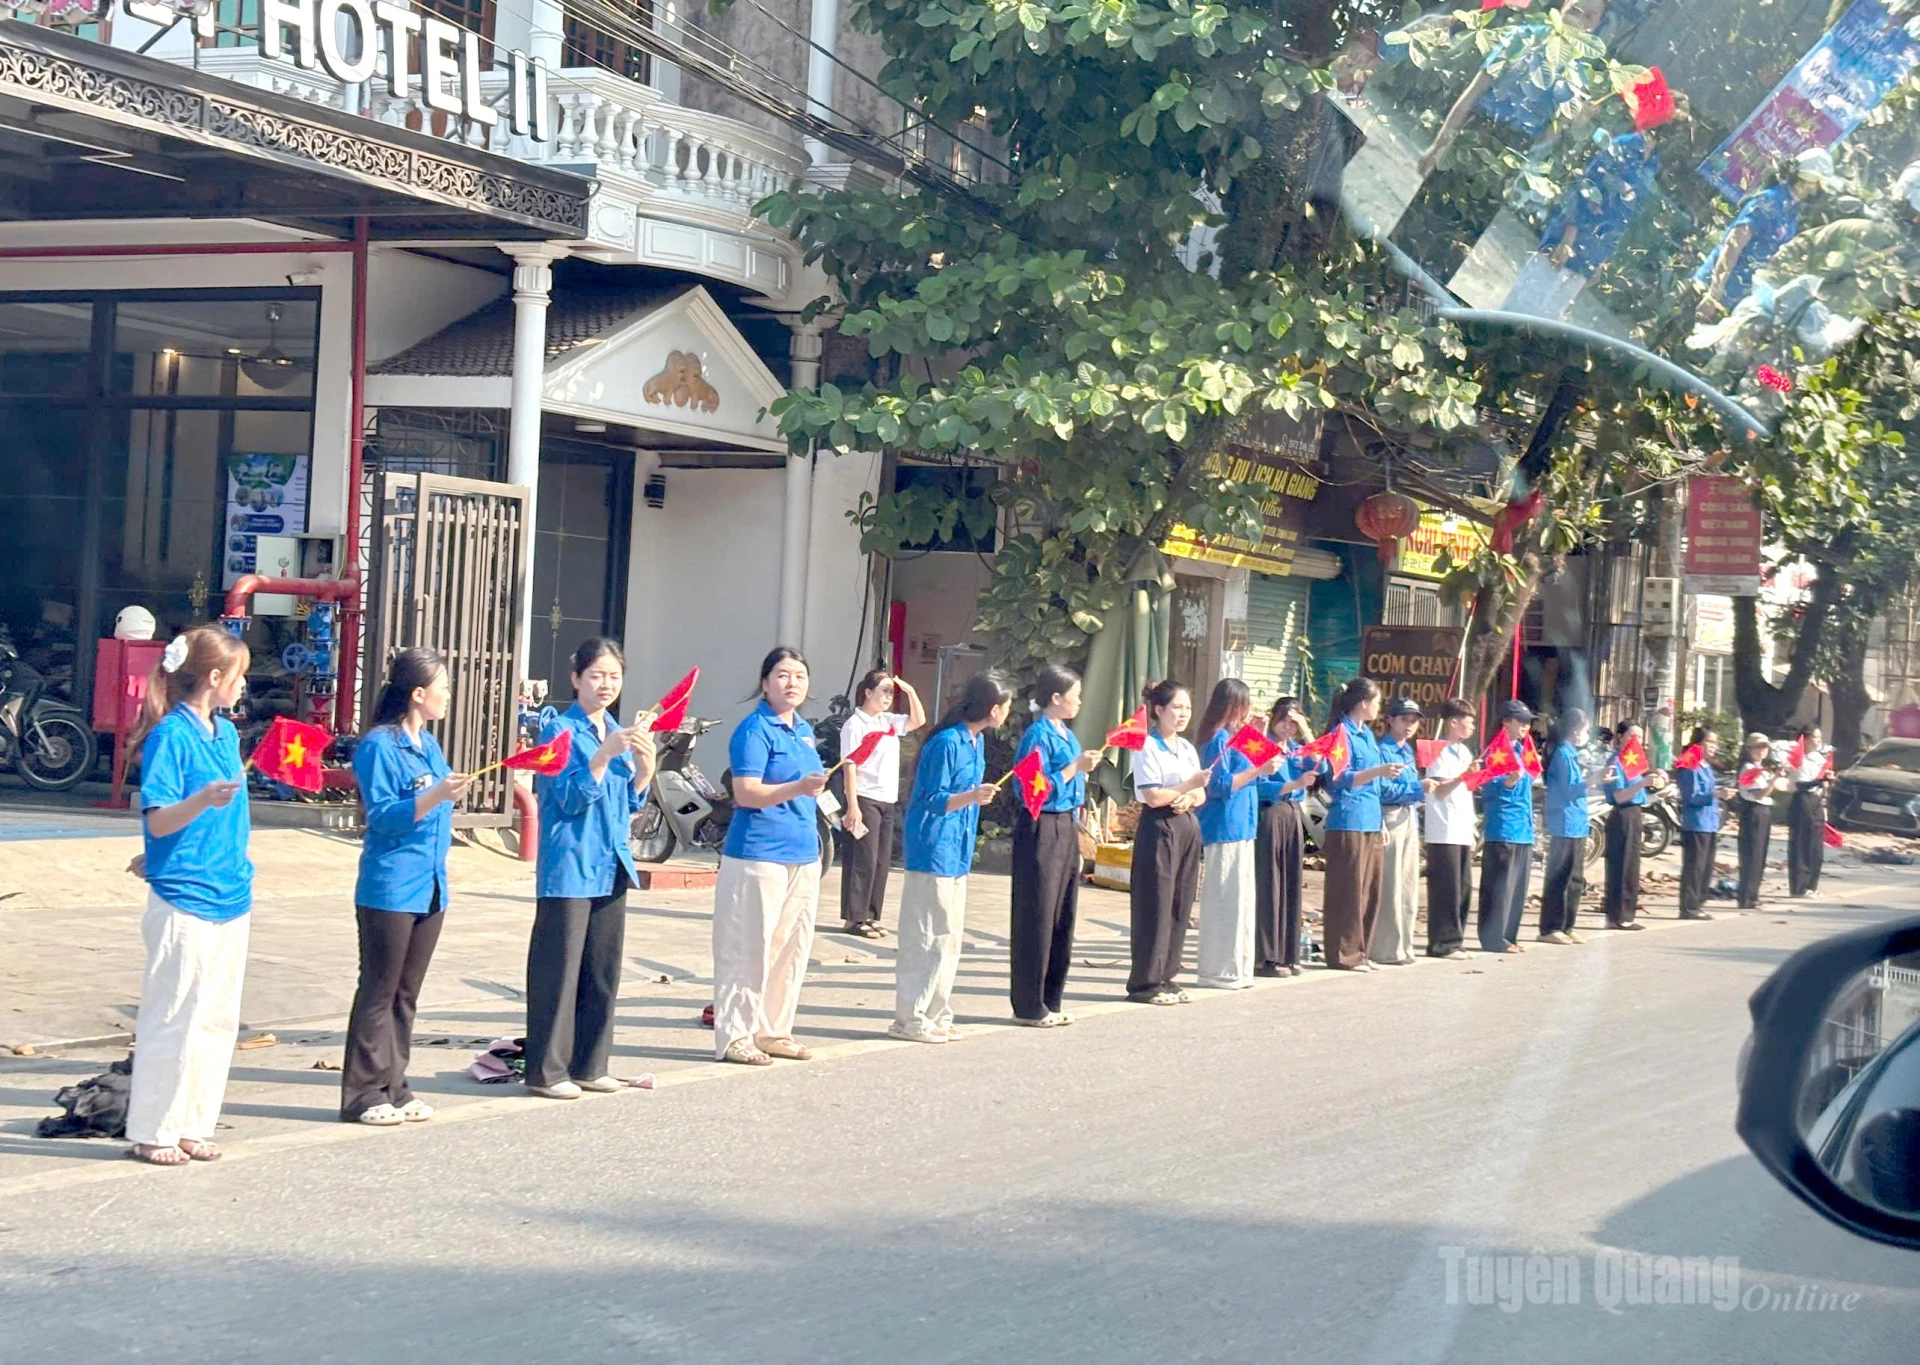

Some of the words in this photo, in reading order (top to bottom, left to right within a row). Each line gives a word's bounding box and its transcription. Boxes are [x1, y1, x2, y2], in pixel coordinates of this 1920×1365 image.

[258, 0, 498, 126] HOTEL
[1286, 473, 1320, 502] GIANG
[1367, 651, 1406, 675] CƠM
[1409, 655, 1455, 677] CHAY
[1398, 681, 1448, 707] CHỌN
